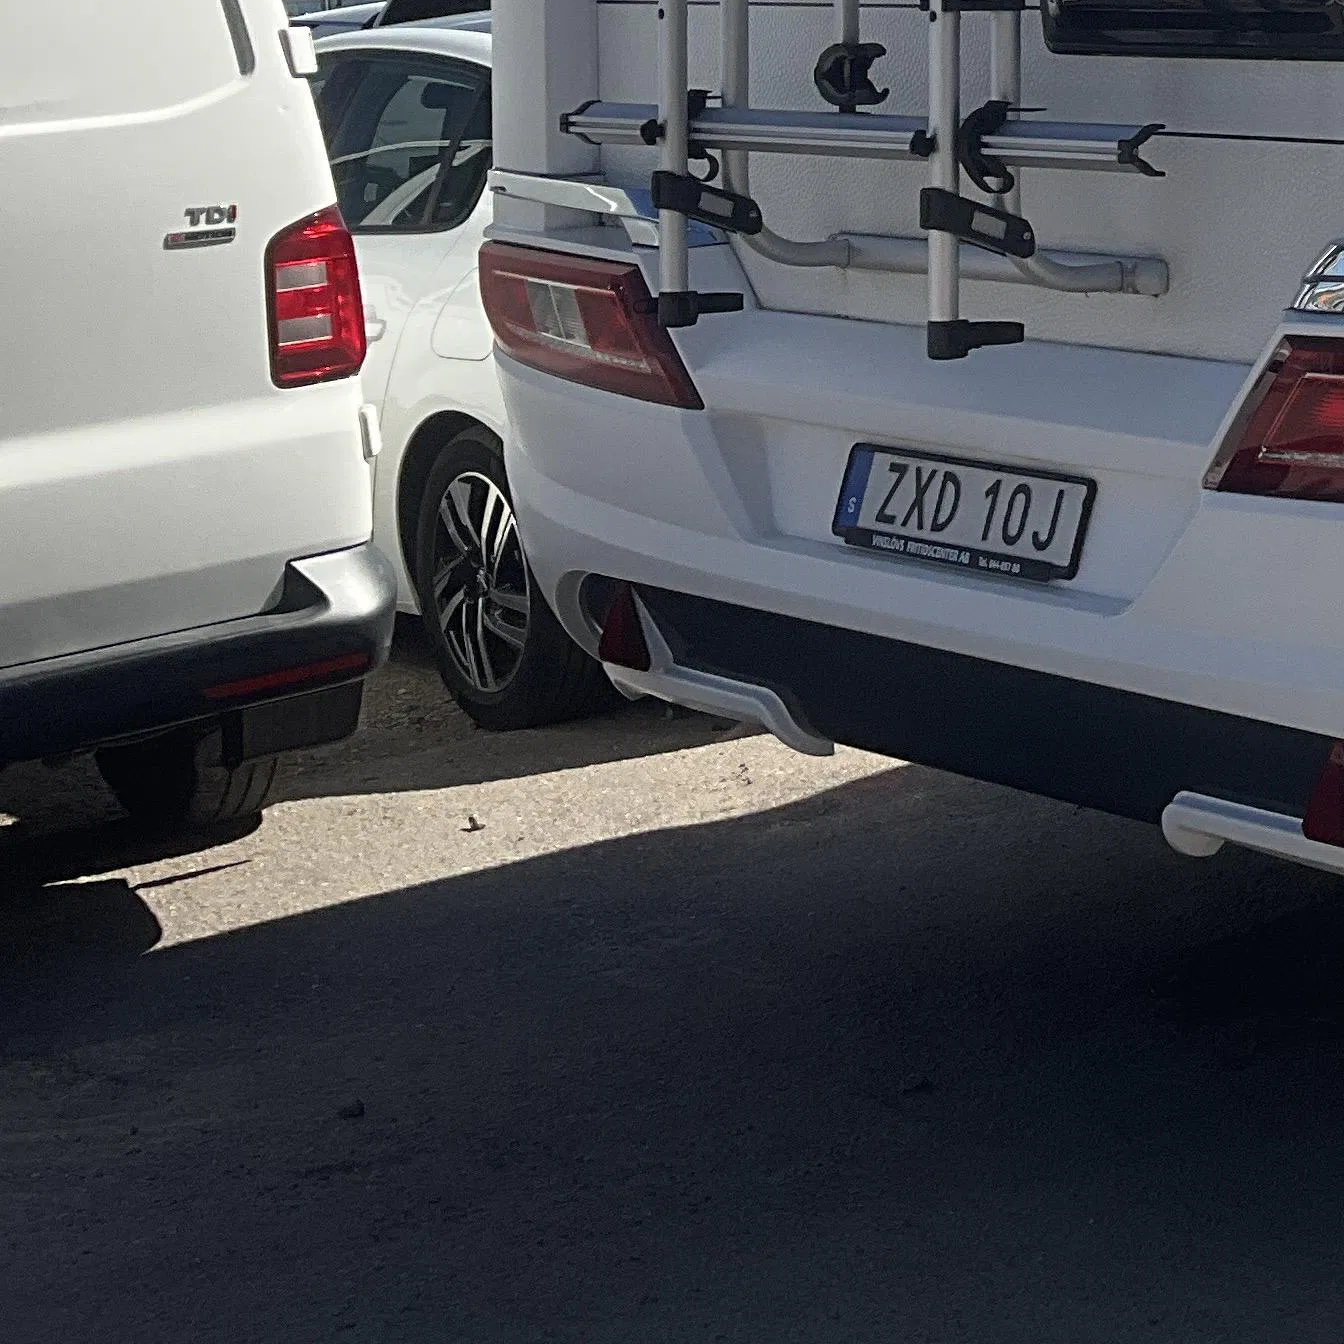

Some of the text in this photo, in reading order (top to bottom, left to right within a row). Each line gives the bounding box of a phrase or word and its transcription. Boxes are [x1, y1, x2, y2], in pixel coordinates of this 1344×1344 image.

[184, 204, 238, 227] TDI
[847, 496, 858, 514] S
[875, 461, 1065, 552] ZXD 10J
